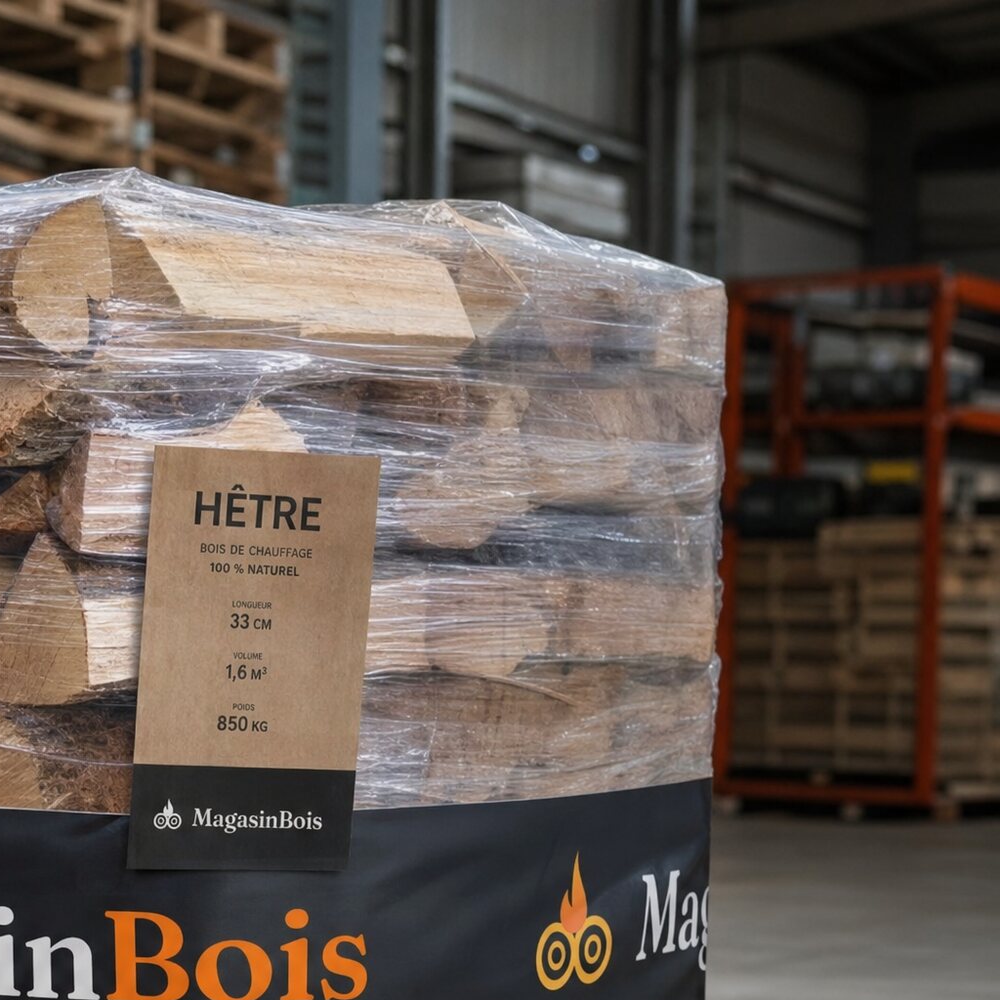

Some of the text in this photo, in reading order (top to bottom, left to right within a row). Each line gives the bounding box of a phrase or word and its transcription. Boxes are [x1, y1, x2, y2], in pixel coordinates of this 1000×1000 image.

[194, 484, 322, 531] HÊTRE
[200, 543, 313, 559] BOIS DE CHAUFFAGE
[210, 563, 300, 577] 100 % NATUREL
[231, 601, 272, 609] LONGUEUR
[230, 613, 272, 630] 33 CM
[233, 652, 263, 660] VOLUME
[225, 664, 247, 682] 1,6
[232, 703, 255, 711] POIDS
[217, 715, 268, 732] 850 KG
[191, 808, 323, 834] MagasinBois
